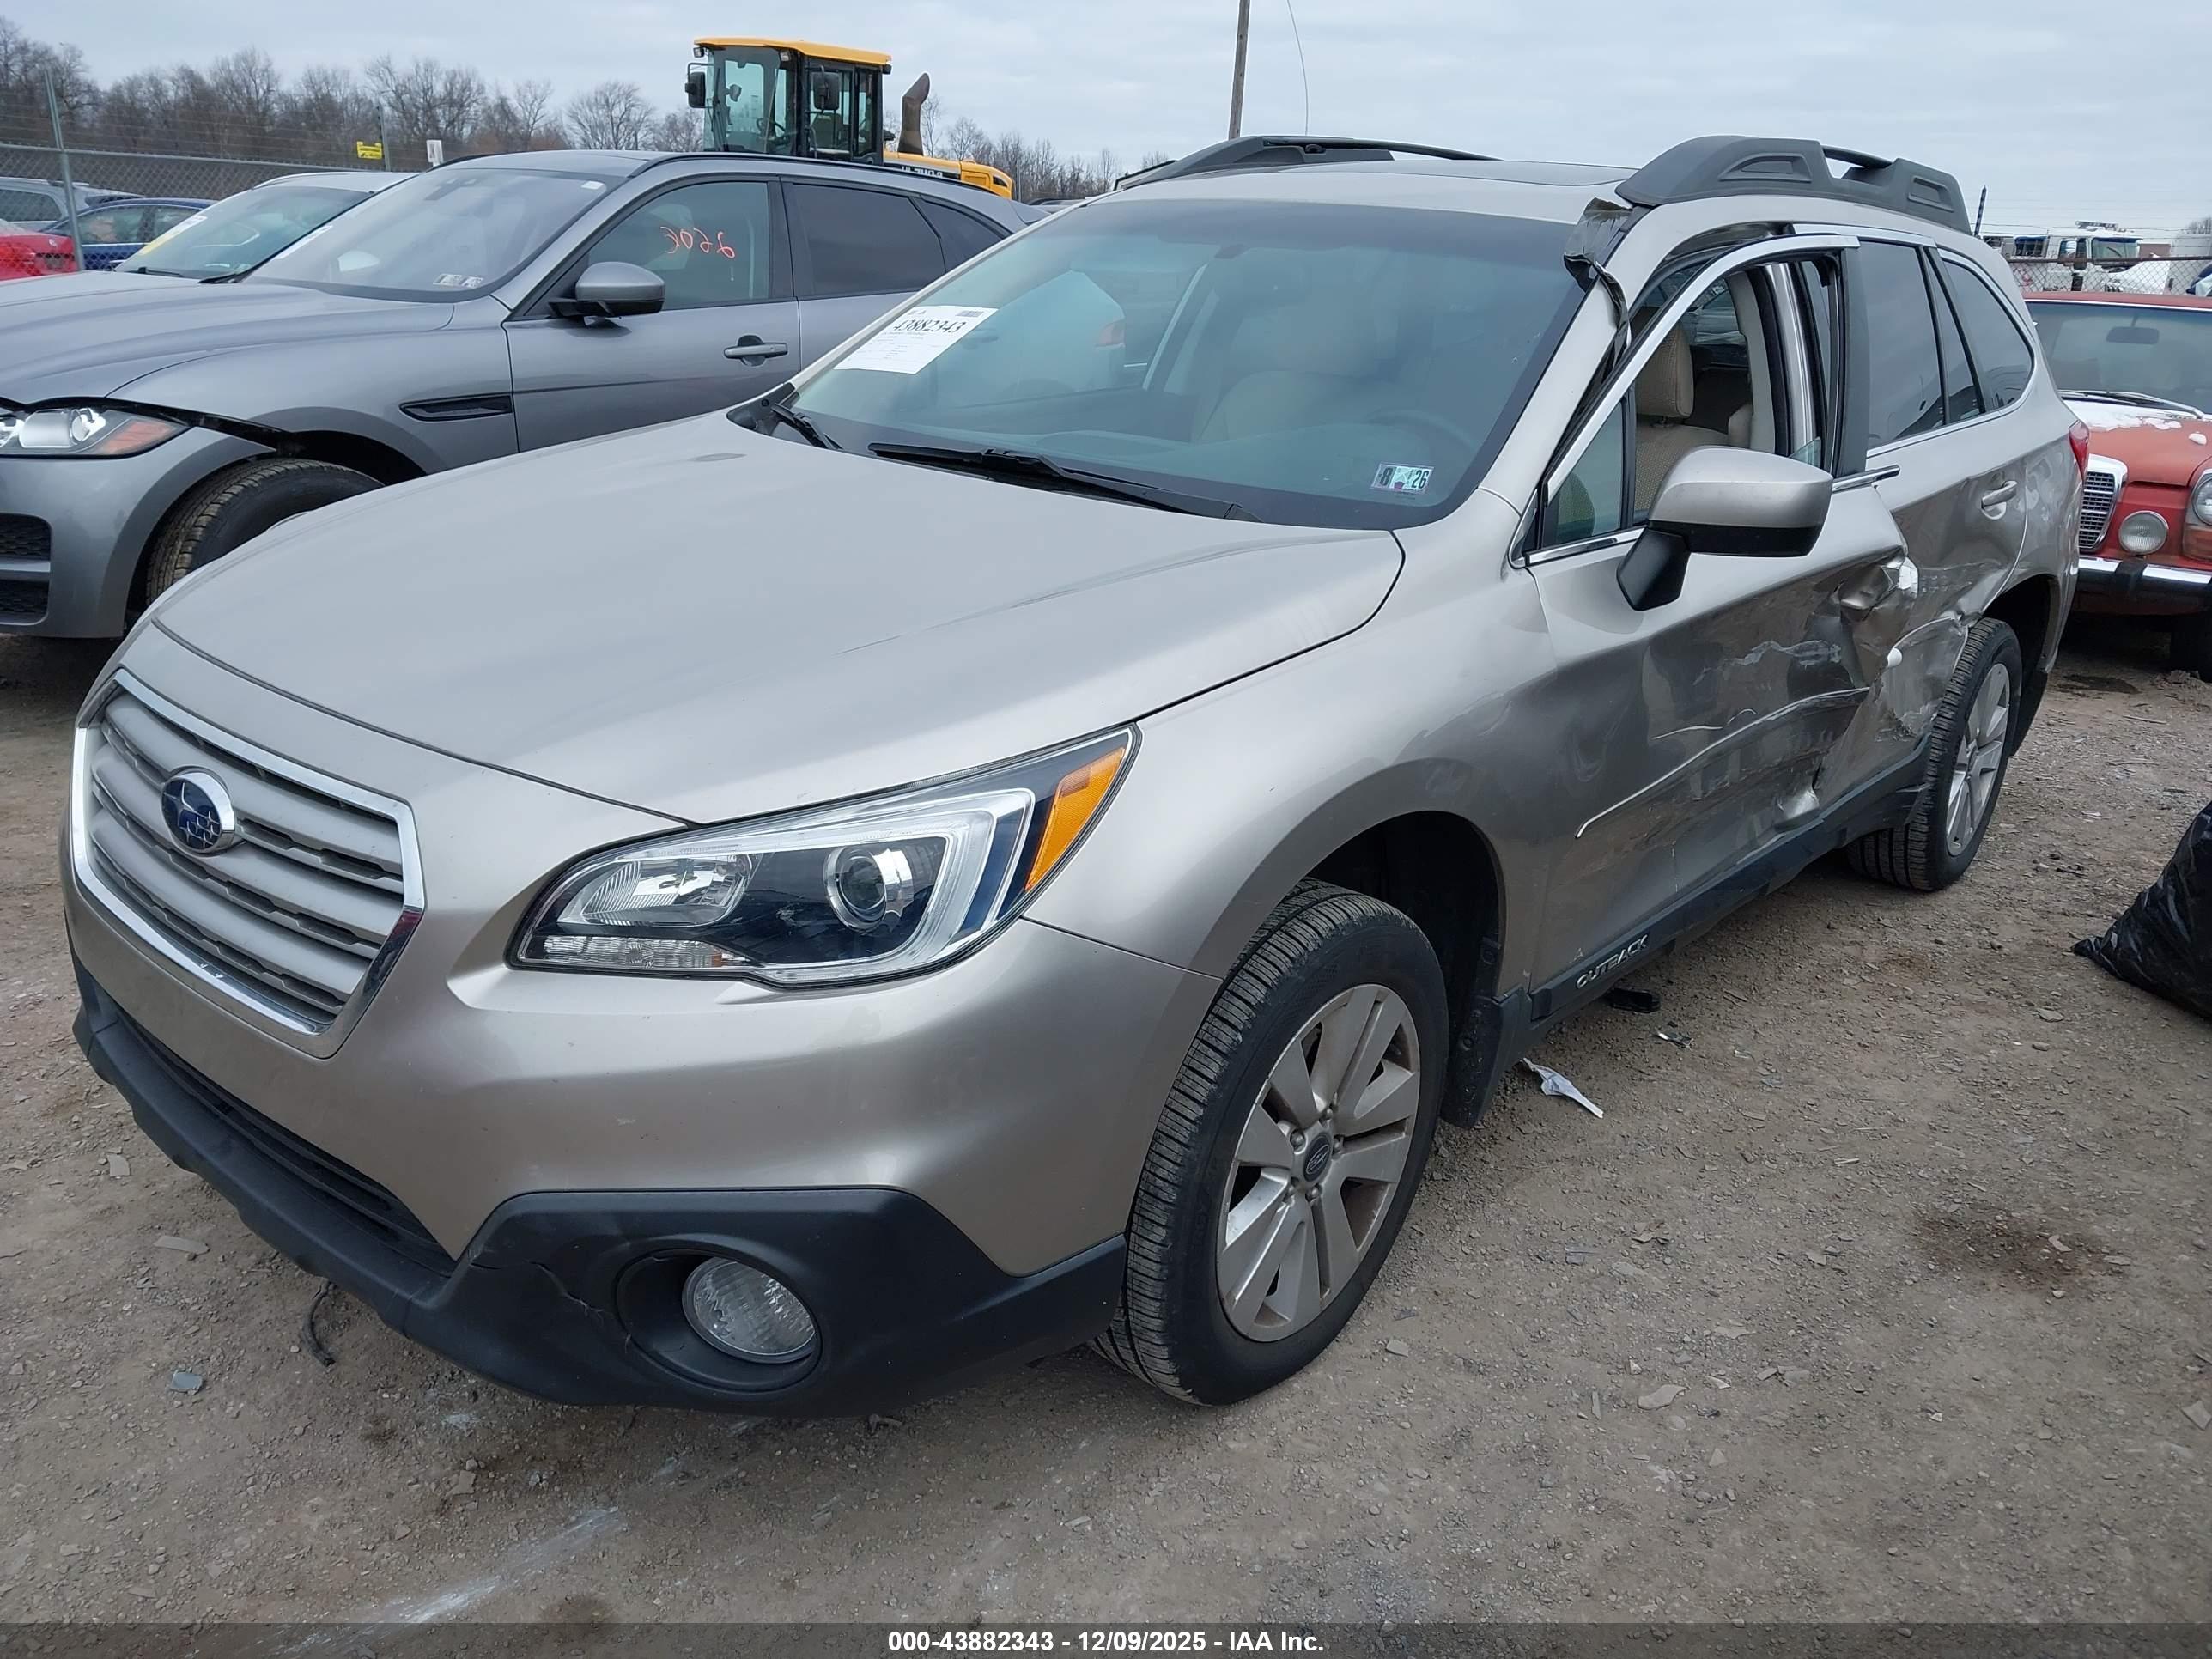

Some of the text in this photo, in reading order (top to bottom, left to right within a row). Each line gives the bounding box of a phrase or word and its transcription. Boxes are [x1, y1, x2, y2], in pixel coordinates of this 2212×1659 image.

[659, 226, 736, 259] 3026
[893, 319, 967, 333] 43882343
[1411, 470, 1430, 489] 26
[1576, 934, 1648, 989] OUTBACK
